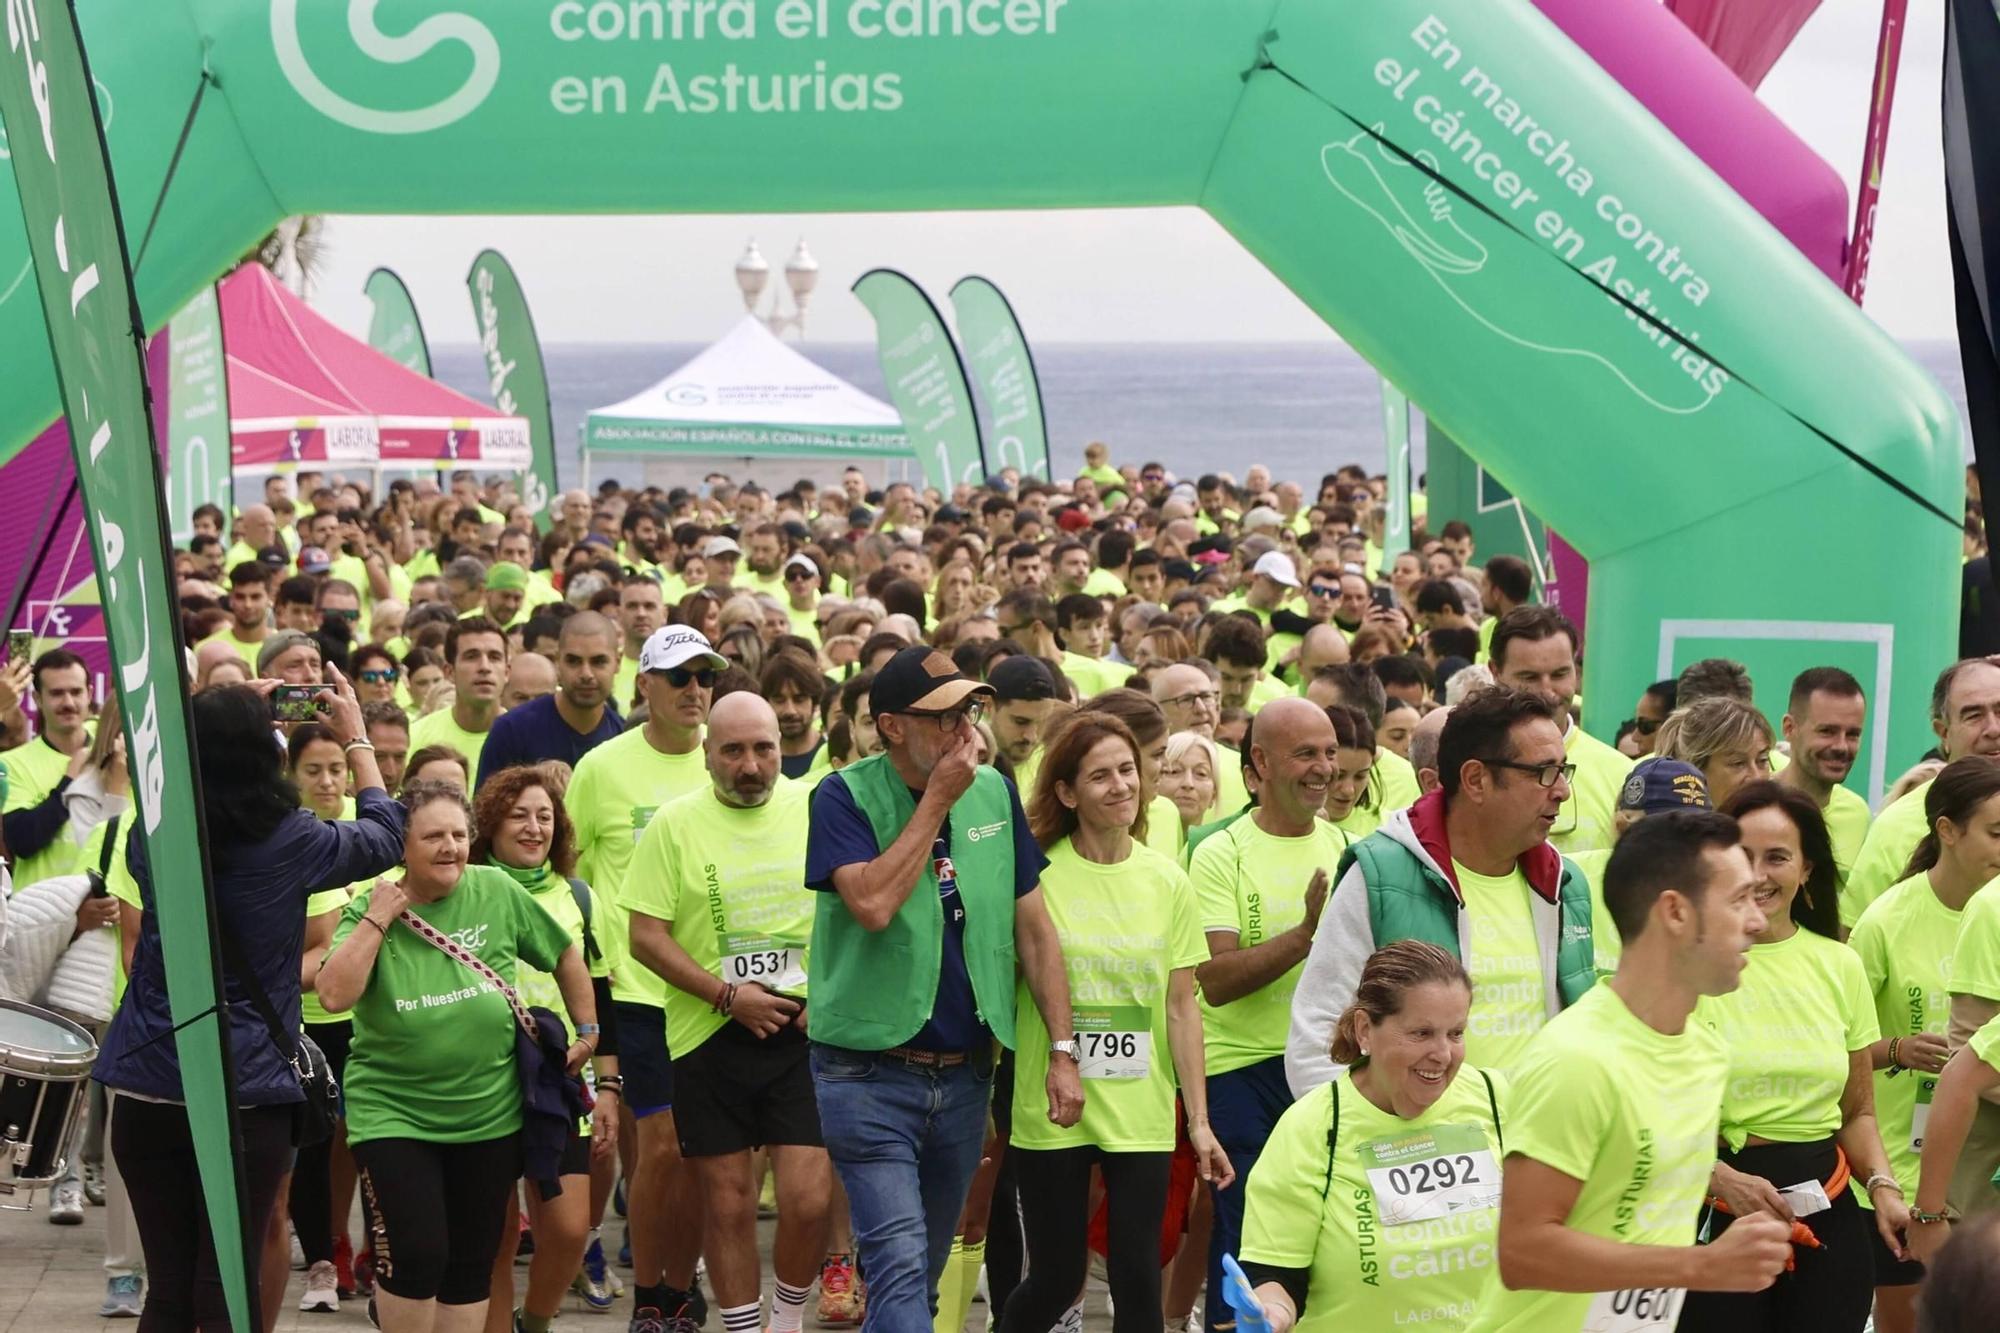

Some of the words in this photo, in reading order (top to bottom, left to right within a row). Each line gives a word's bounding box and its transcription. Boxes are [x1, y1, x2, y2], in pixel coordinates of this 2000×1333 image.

[550, 0, 756, 41] contra
[774, 0, 828, 38] el
[549, 75, 627, 114] en
[643, 60, 904, 113] Asturias
[1373, 58, 1421, 101] el
[1413, 95, 1539, 210] cáncer
[1534, 210, 1586, 261] en
[1411, 14, 1462, 71] En
[1459, 66, 1594, 197] marcha
[1596, 194, 1711, 307] contra
[704, 863, 726, 933] ASTURIAS
[735, 949, 789, 978] 0531
[1068, 955, 1138, 974] ontra
[395, 999, 419, 1012] Por
[421, 986, 478, 1008] Nuestras
[1070, 975, 1158, 1001] áncer
[1388, 1155, 1480, 1196] 0292
[1612, 1127, 1653, 1236] ASTURIAS
[1354, 1187, 1380, 1288] ASTURIAS
[1389, 1241, 1497, 1280] cánc
